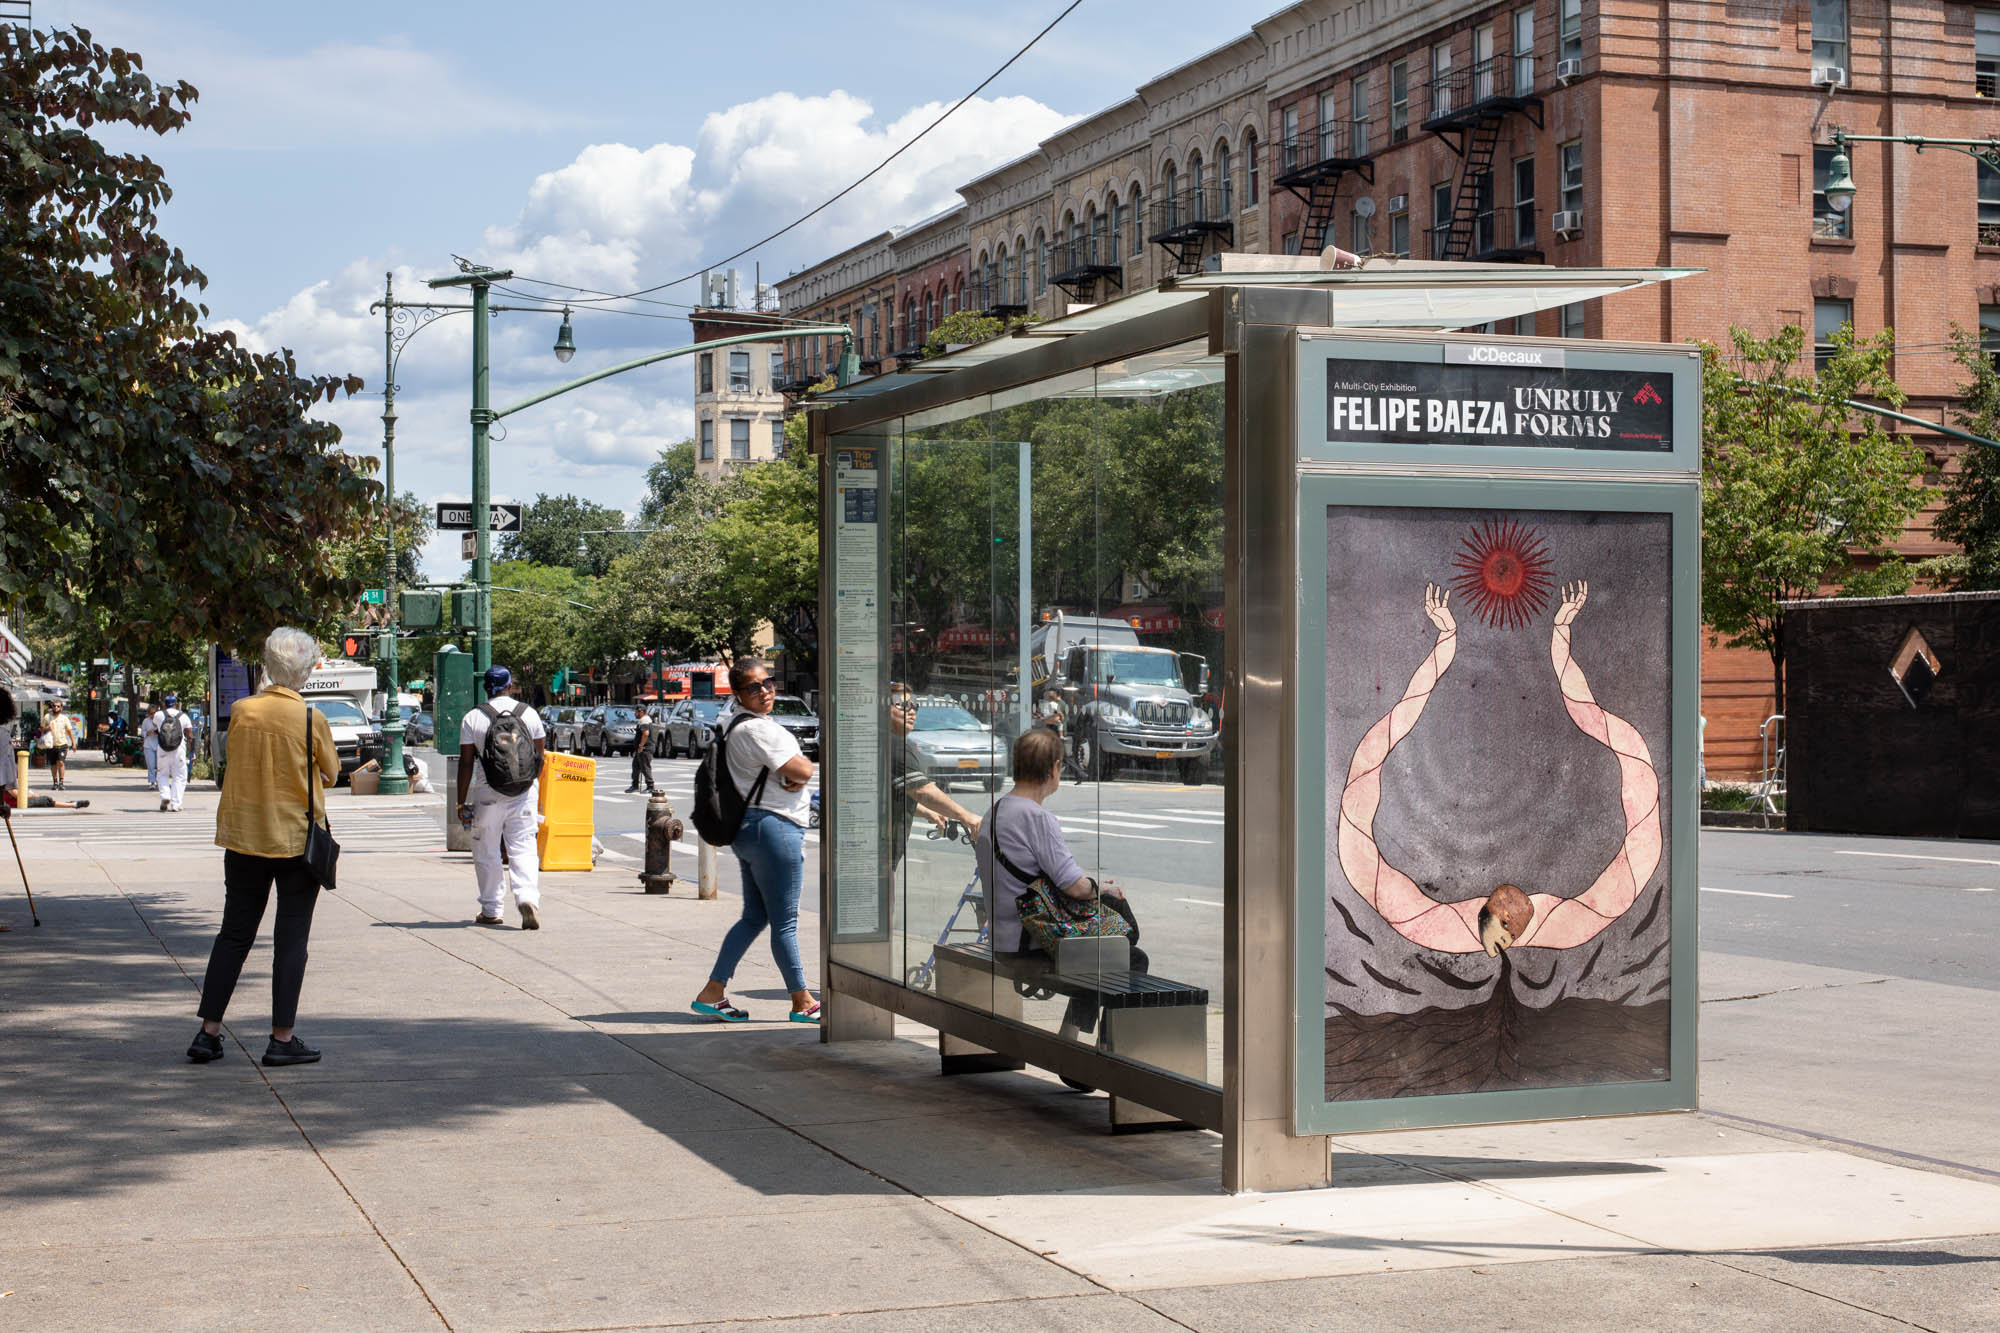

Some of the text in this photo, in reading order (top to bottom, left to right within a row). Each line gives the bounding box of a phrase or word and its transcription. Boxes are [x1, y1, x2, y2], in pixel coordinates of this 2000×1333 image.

[1468, 347, 1542, 364] JCDecaux
[1334, 382, 1417, 392] A Multi-City Exhibition
[1514, 387, 1624, 413] UNRULY
[1333, 396, 1508, 435] FELIPE BAEZA
[1513, 413, 1612, 438] FORMS
[449, 511, 508, 523] ONE AY
[561, 773, 587, 783] GRATIS
